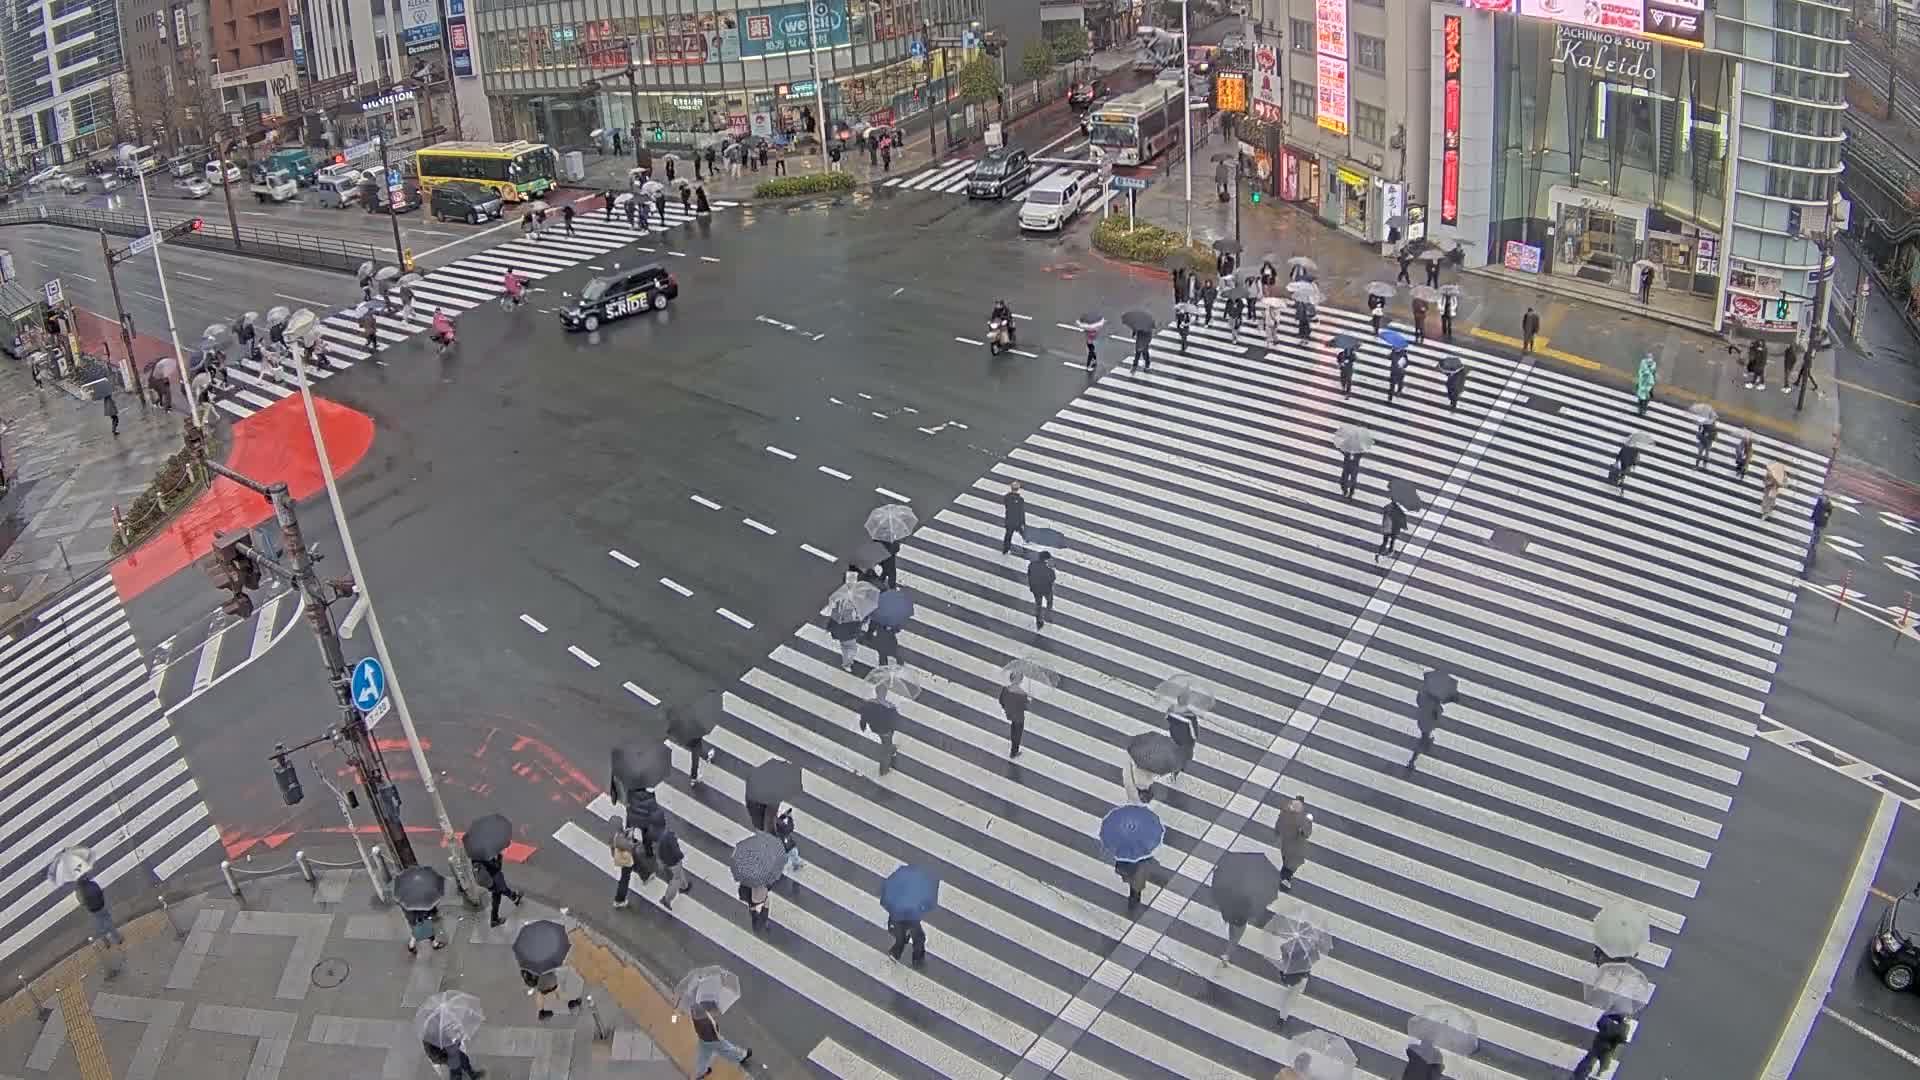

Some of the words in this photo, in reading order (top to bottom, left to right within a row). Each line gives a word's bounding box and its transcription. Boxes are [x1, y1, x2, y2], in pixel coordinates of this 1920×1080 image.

[1557, 24, 1612, 45] PACHINKO
[1614, 36, 1623, 46] &
[1624, 37, 1651, 52] SLOT
[1551, 37, 1657, 79] Kaleido
[605, 292, 649, 319] S.RIDE
